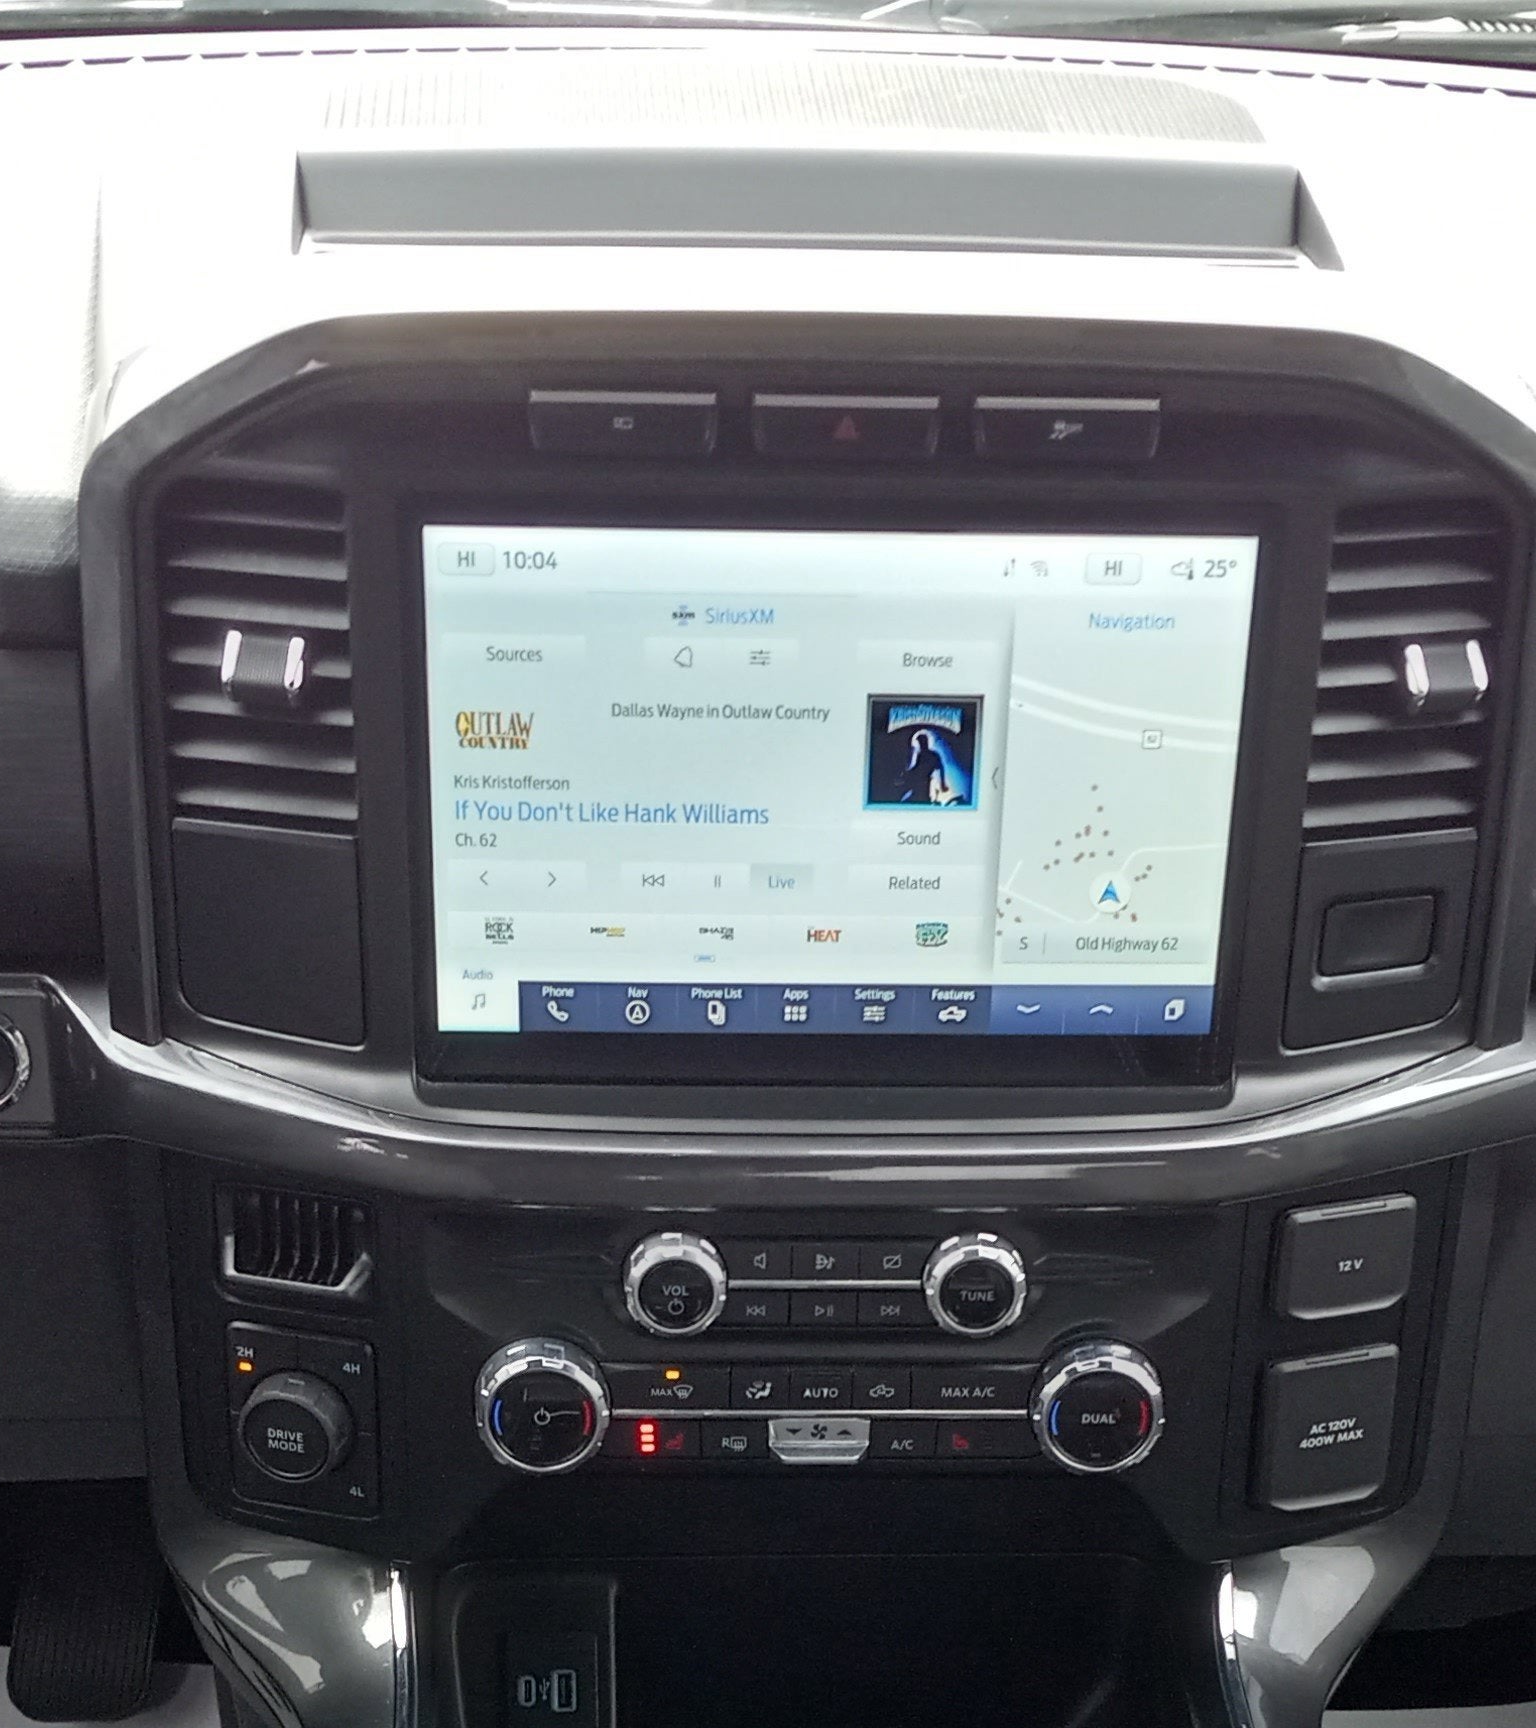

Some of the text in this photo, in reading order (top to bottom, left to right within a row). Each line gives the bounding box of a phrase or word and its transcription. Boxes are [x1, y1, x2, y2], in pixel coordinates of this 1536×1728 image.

[457, 551, 476, 568] HI
[503, 551, 558, 570] 10:04
[1105, 560, 1123, 577] HI
[705, 607, 776, 625] SiriusXM
[1089, 613, 1176, 632] Navigation
[486, 646, 543, 662] Sources
[902, 652, 953, 668] Browse
[611, 703, 831, 723] Dallas Wayne in Outlaw Country
[455, 711, 535, 739] OUTLAW
[459, 736, 530, 750] COUNTRY
[454, 775, 570, 791] Kris Kristofferson
[454, 800, 770, 825] If You Don't Like Hank Williams
[455, 833, 498, 848] Ch. 62
[897, 831, 942, 845] Sound
[768, 875, 795, 889] Live
[888, 876, 941, 890] Related
[807, 929, 842, 943] HEAT
[1019, 936, 1029, 951] S
[1075, 937, 1179, 954] Old Highway 62
[462, 968, 493, 981] Audio
[541, 985, 575, 998] Phone
[627, 986, 649, 998] Nav
[691, 988, 743, 1001] Phone List
[783, 988, 809, 1002] Apps
[854, 988, 896, 1002] Settings
[930, 989, 975, 1002] Features
[662, 1284, 690, 1297] VOL
[959, 1290, 996, 1302] TUNE
[235, 1346, 254, 1358] 2H
[342, 1362, 361, 1375] 4H
[650, 1388, 674, 1398] MAX
[803, 1387, 839, 1399] AUTO
[941, 1386, 995, 1399] MAX A/C
[1081, 1412, 1116, 1425] DUAL
[1310, 1417, 1357, 1435] AC 120V
[267, 1427, 304, 1442] DRIVE
[1299, 1428, 1364, 1449] 400W MAX
[267, 1439, 305, 1453] MODE
[890, 1438, 914, 1450] A/C
[349, 1485, 365, 1498] 4L
